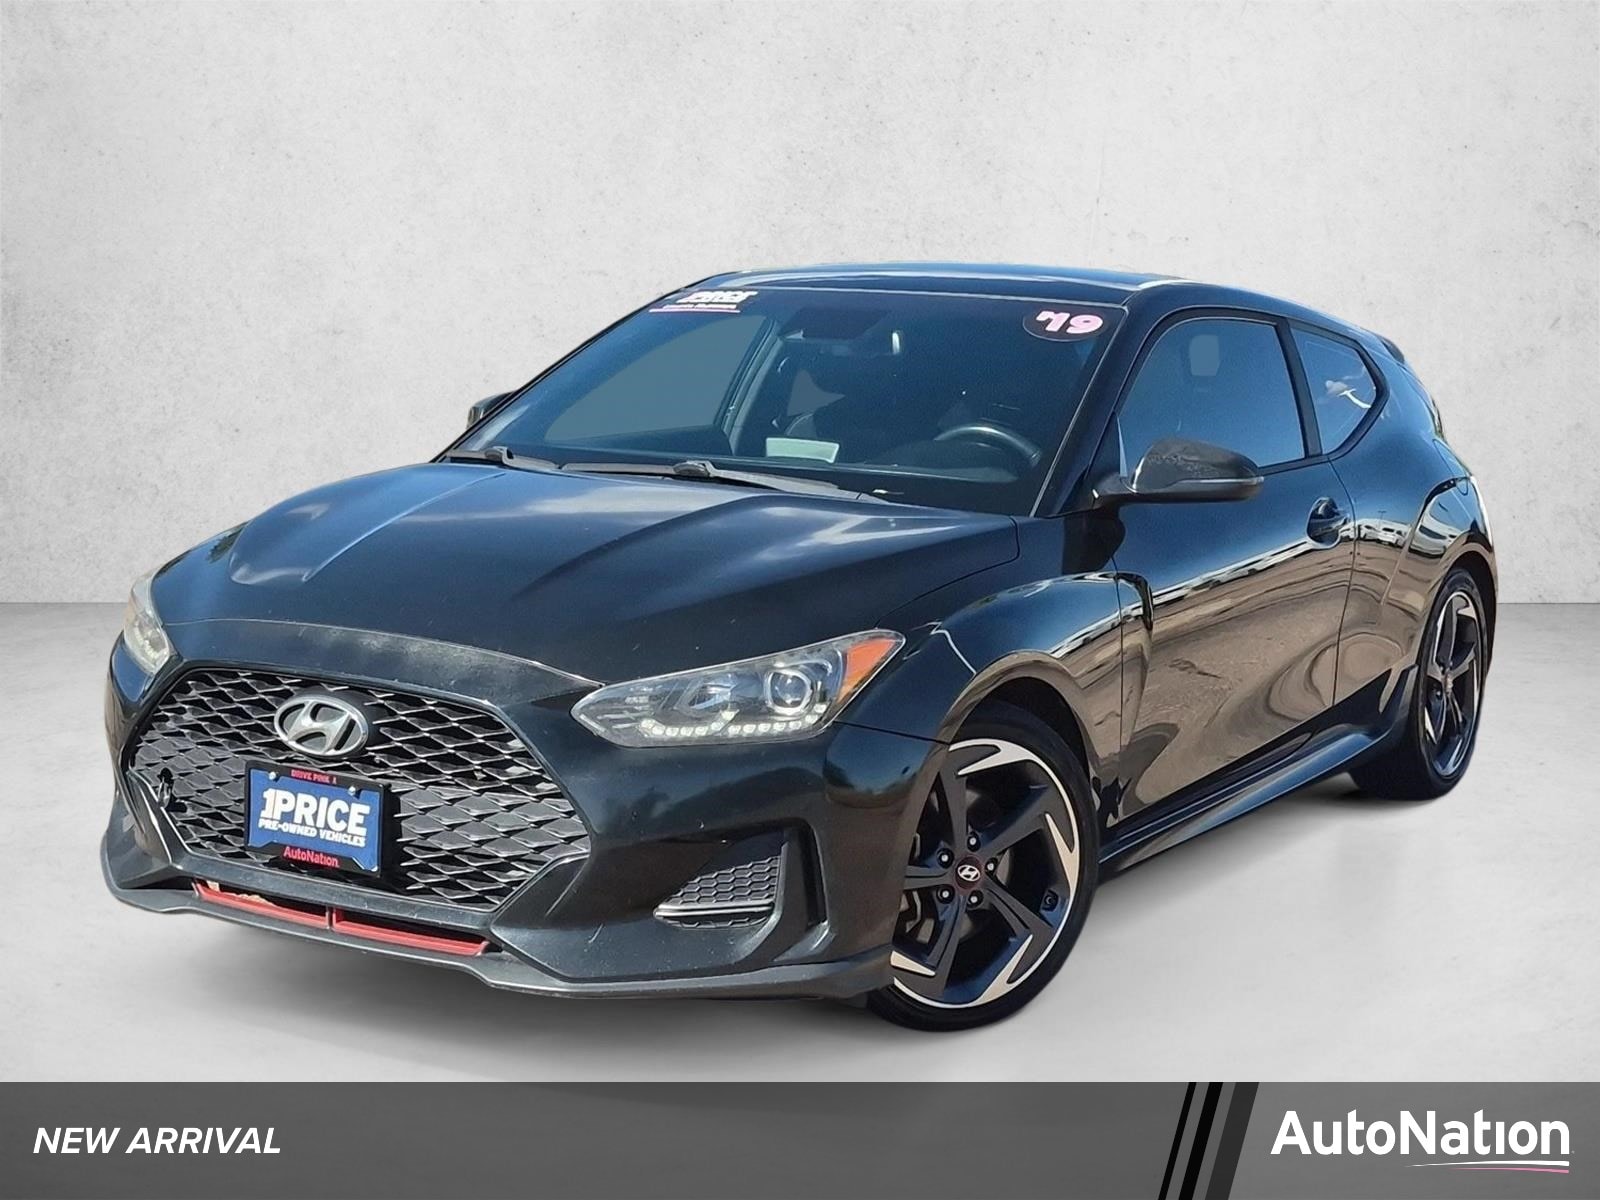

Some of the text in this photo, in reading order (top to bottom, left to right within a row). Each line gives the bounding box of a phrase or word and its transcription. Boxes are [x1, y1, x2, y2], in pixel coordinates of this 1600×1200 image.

[258, 818, 366, 848] PRE-OWNED VEHICLES
[283, 846, 339, 868] AutoNation
